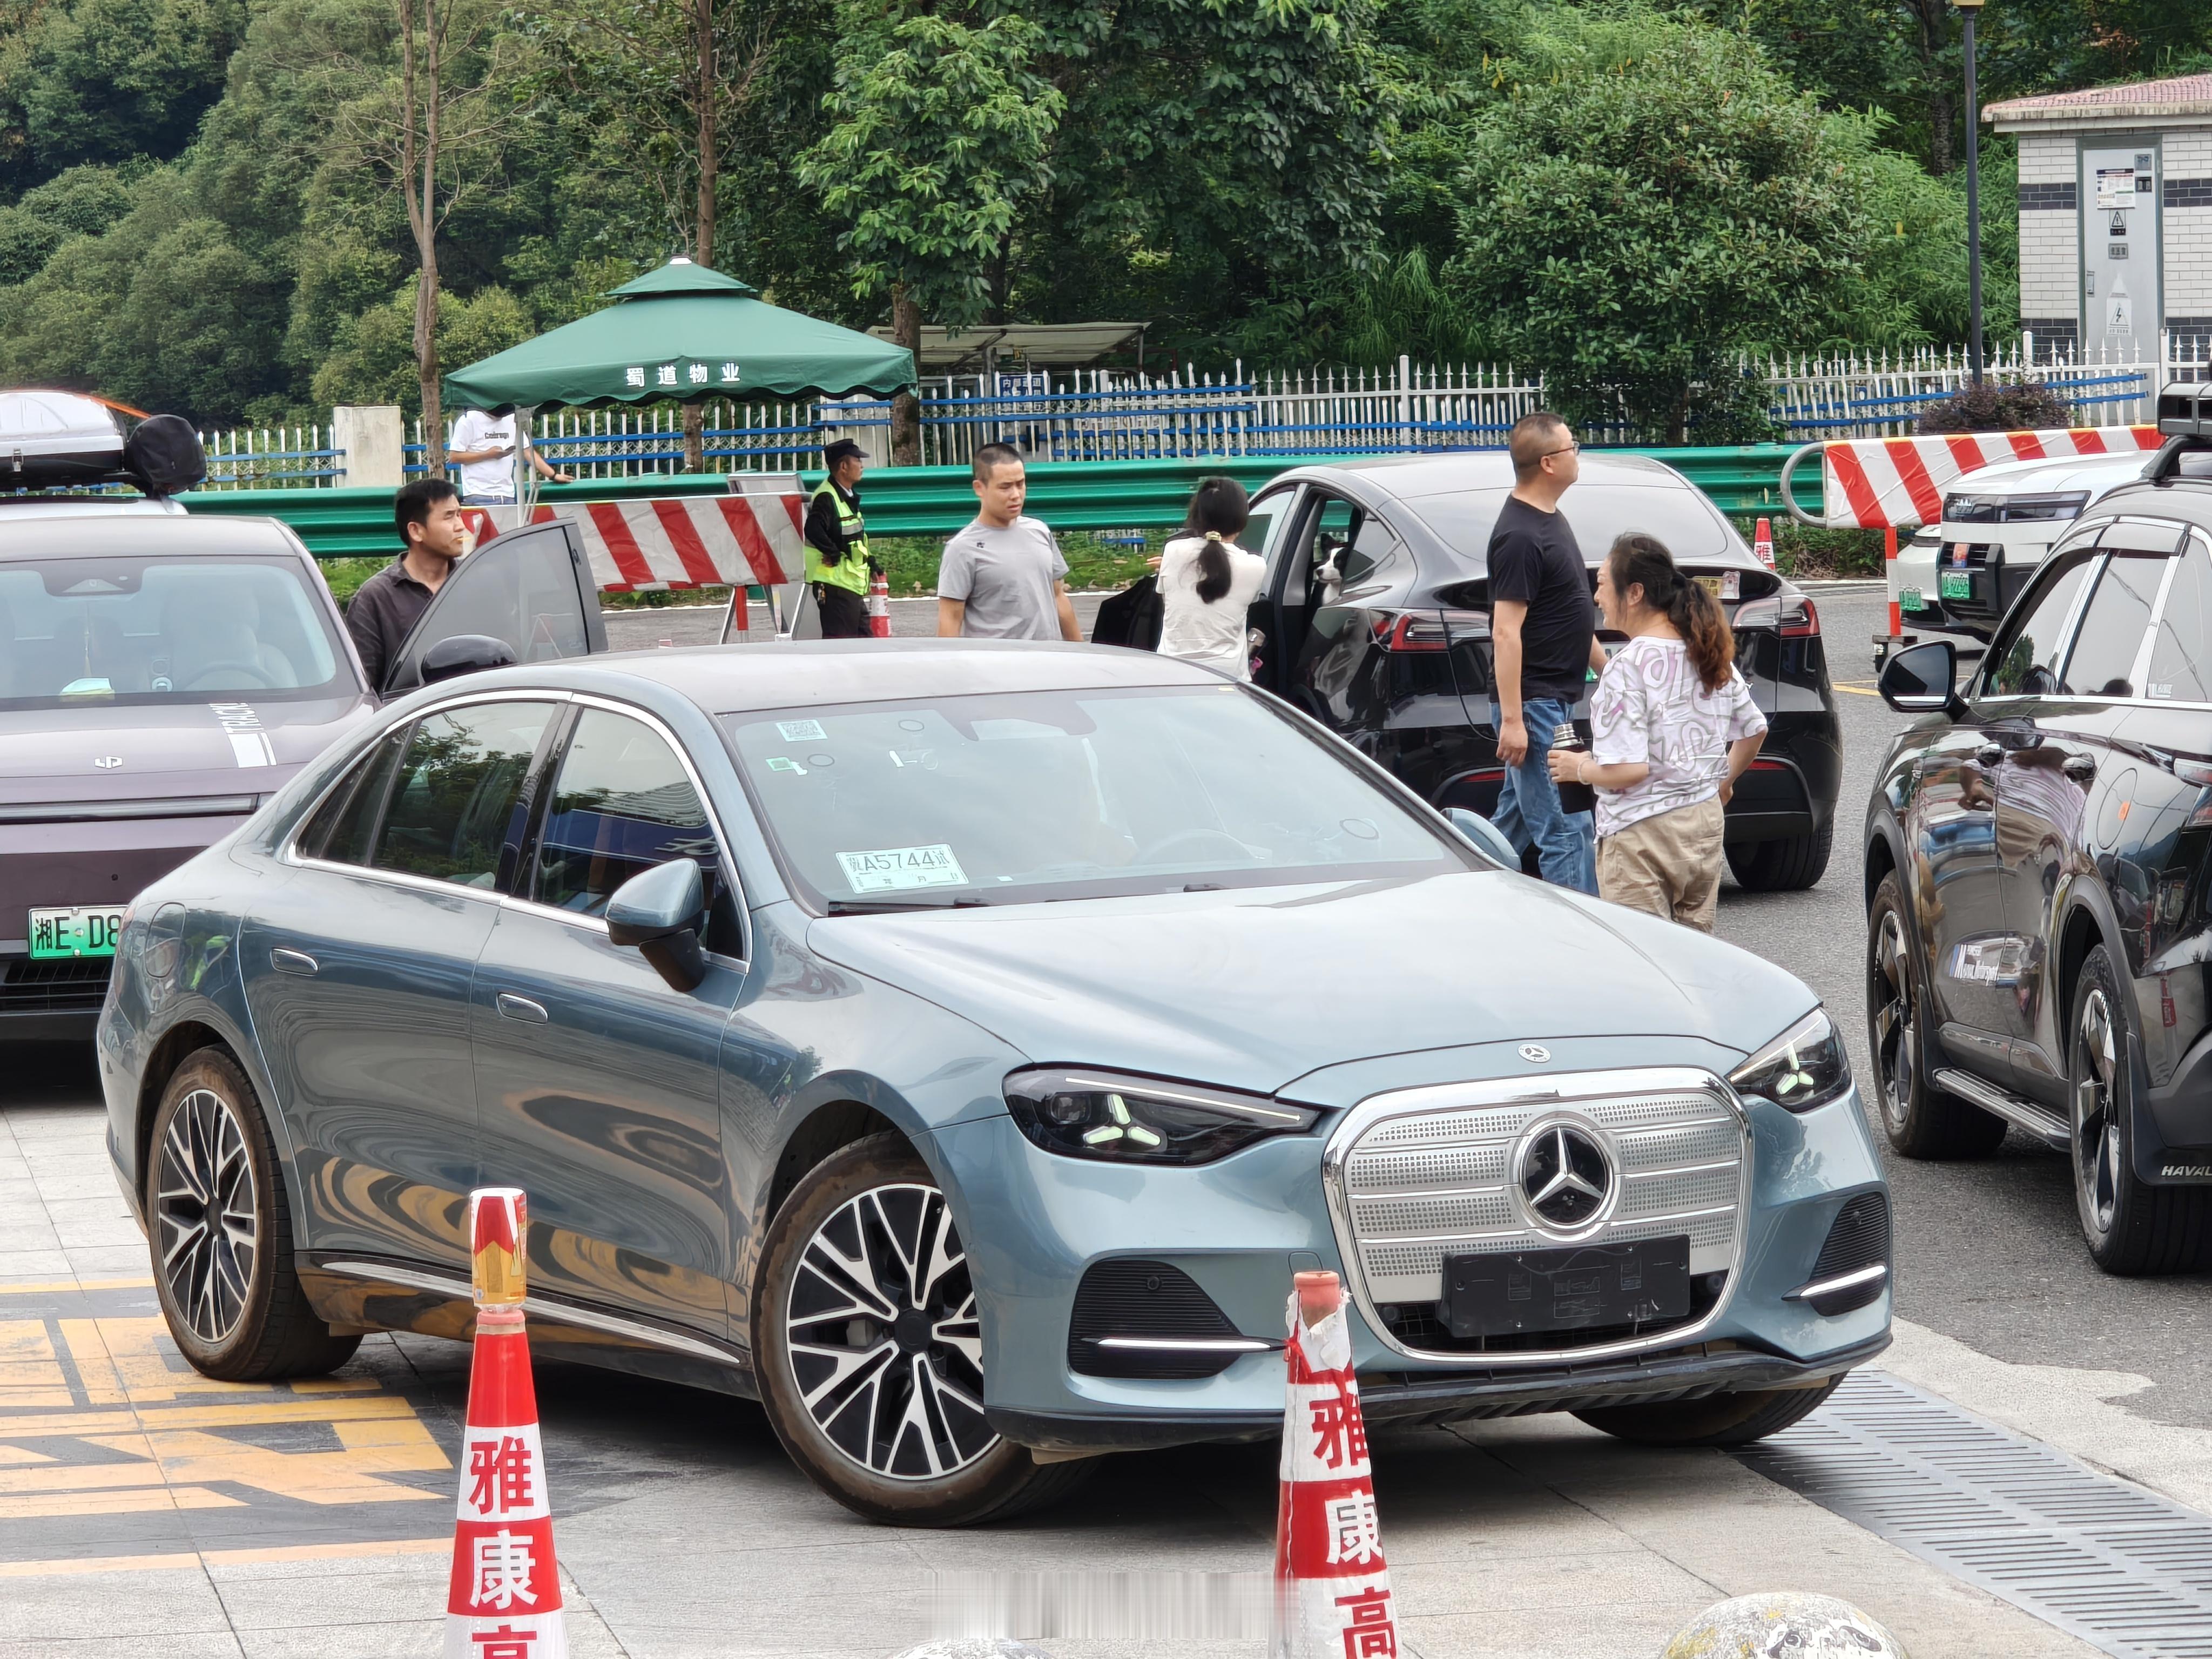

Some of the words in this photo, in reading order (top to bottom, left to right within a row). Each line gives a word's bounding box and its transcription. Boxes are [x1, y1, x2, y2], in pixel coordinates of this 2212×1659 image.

[626, 363, 740, 387] 蜀道物业
[1756, 543, 1771, 562] 雅
[2161, 1165, 2212, 1176] HAVAL
